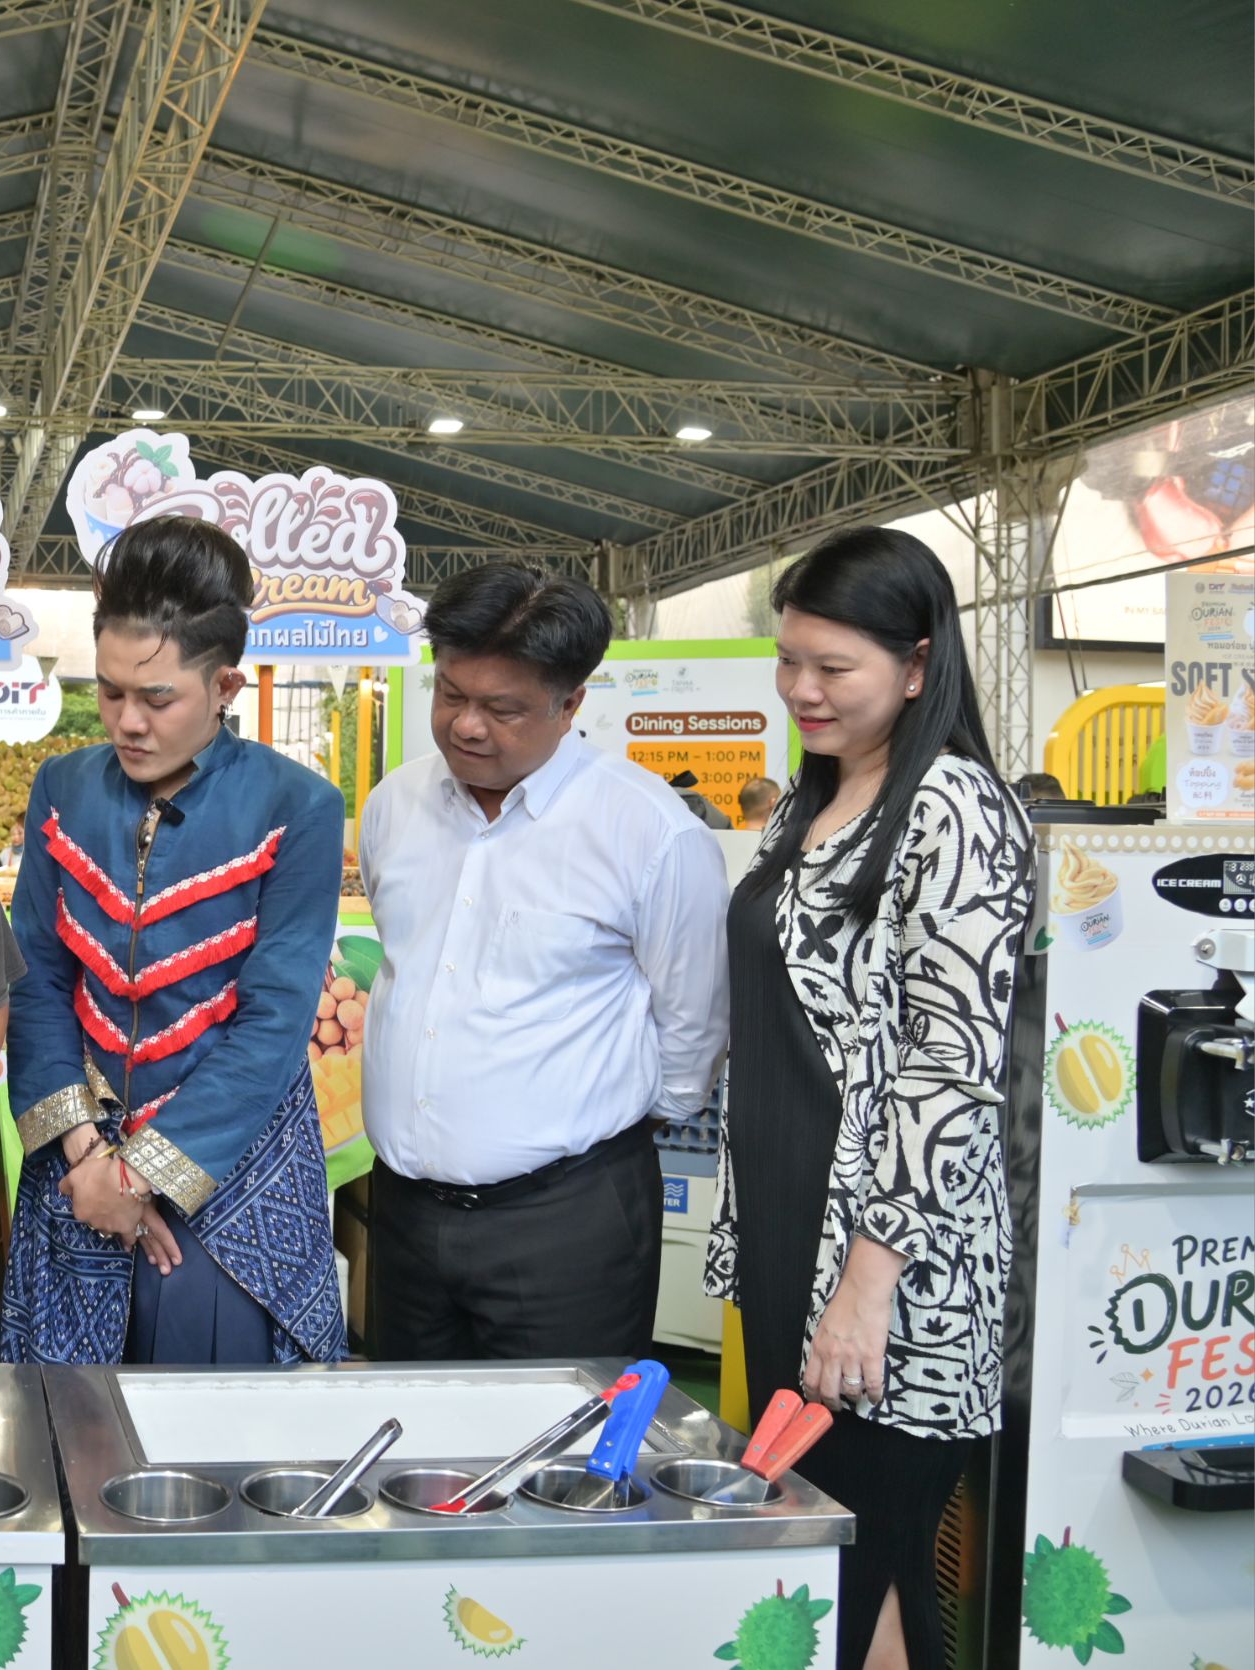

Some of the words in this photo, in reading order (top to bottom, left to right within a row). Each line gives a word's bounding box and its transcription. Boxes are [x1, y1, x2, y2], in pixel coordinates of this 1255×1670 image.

[248, 620, 368, 648] ากผลไม้ไทย
[1171, 661, 1232, 698] SOFT
[631, 716, 684, 734] Dining
[687, 715, 762, 731] Sessions
[632, 751, 664, 762] 12:15
[667, 751, 689, 762] PM
[706, 751, 736, 761] 1:00
[739, 751, 761, 761] PM
[701, 772, 733, 783] 3:00
[1156, 879, 1177, 887] ICE
[1178, 879, 1222, 888] CREAM
[1167, 1332, 1254, 1389] FES
[1124, 1422, 1176, 1437] Where
[1178, 1415, 1231, 1431] Durian
